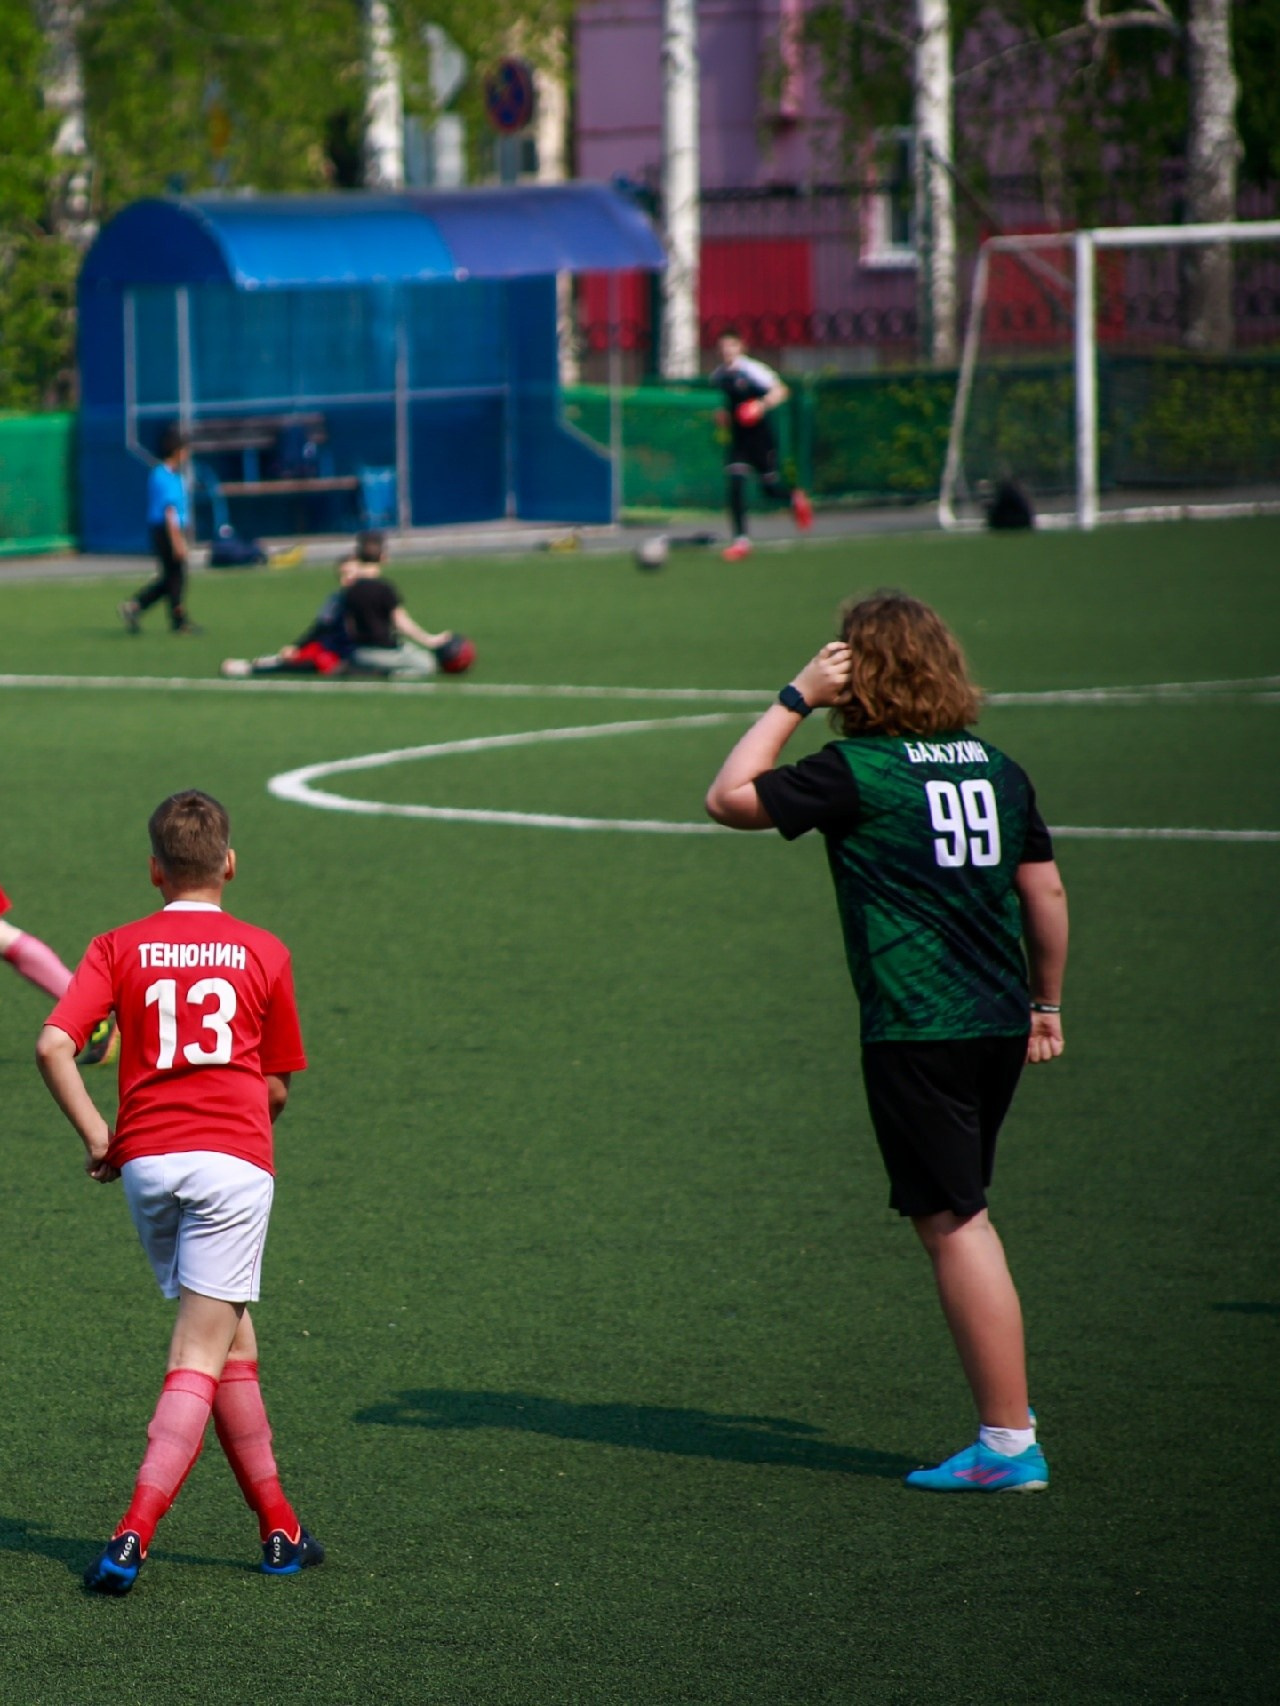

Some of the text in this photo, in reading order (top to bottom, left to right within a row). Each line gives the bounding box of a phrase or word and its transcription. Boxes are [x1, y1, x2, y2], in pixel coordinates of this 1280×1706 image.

[925, 779, 1001, 867] 99
[138, 942, 247, 970] ТЕНЮНИН
[145, 977, 237, 1070] 13
[119, 1535, 136, 1562] COPA
[272, 1535, 281, 1564] COPA
